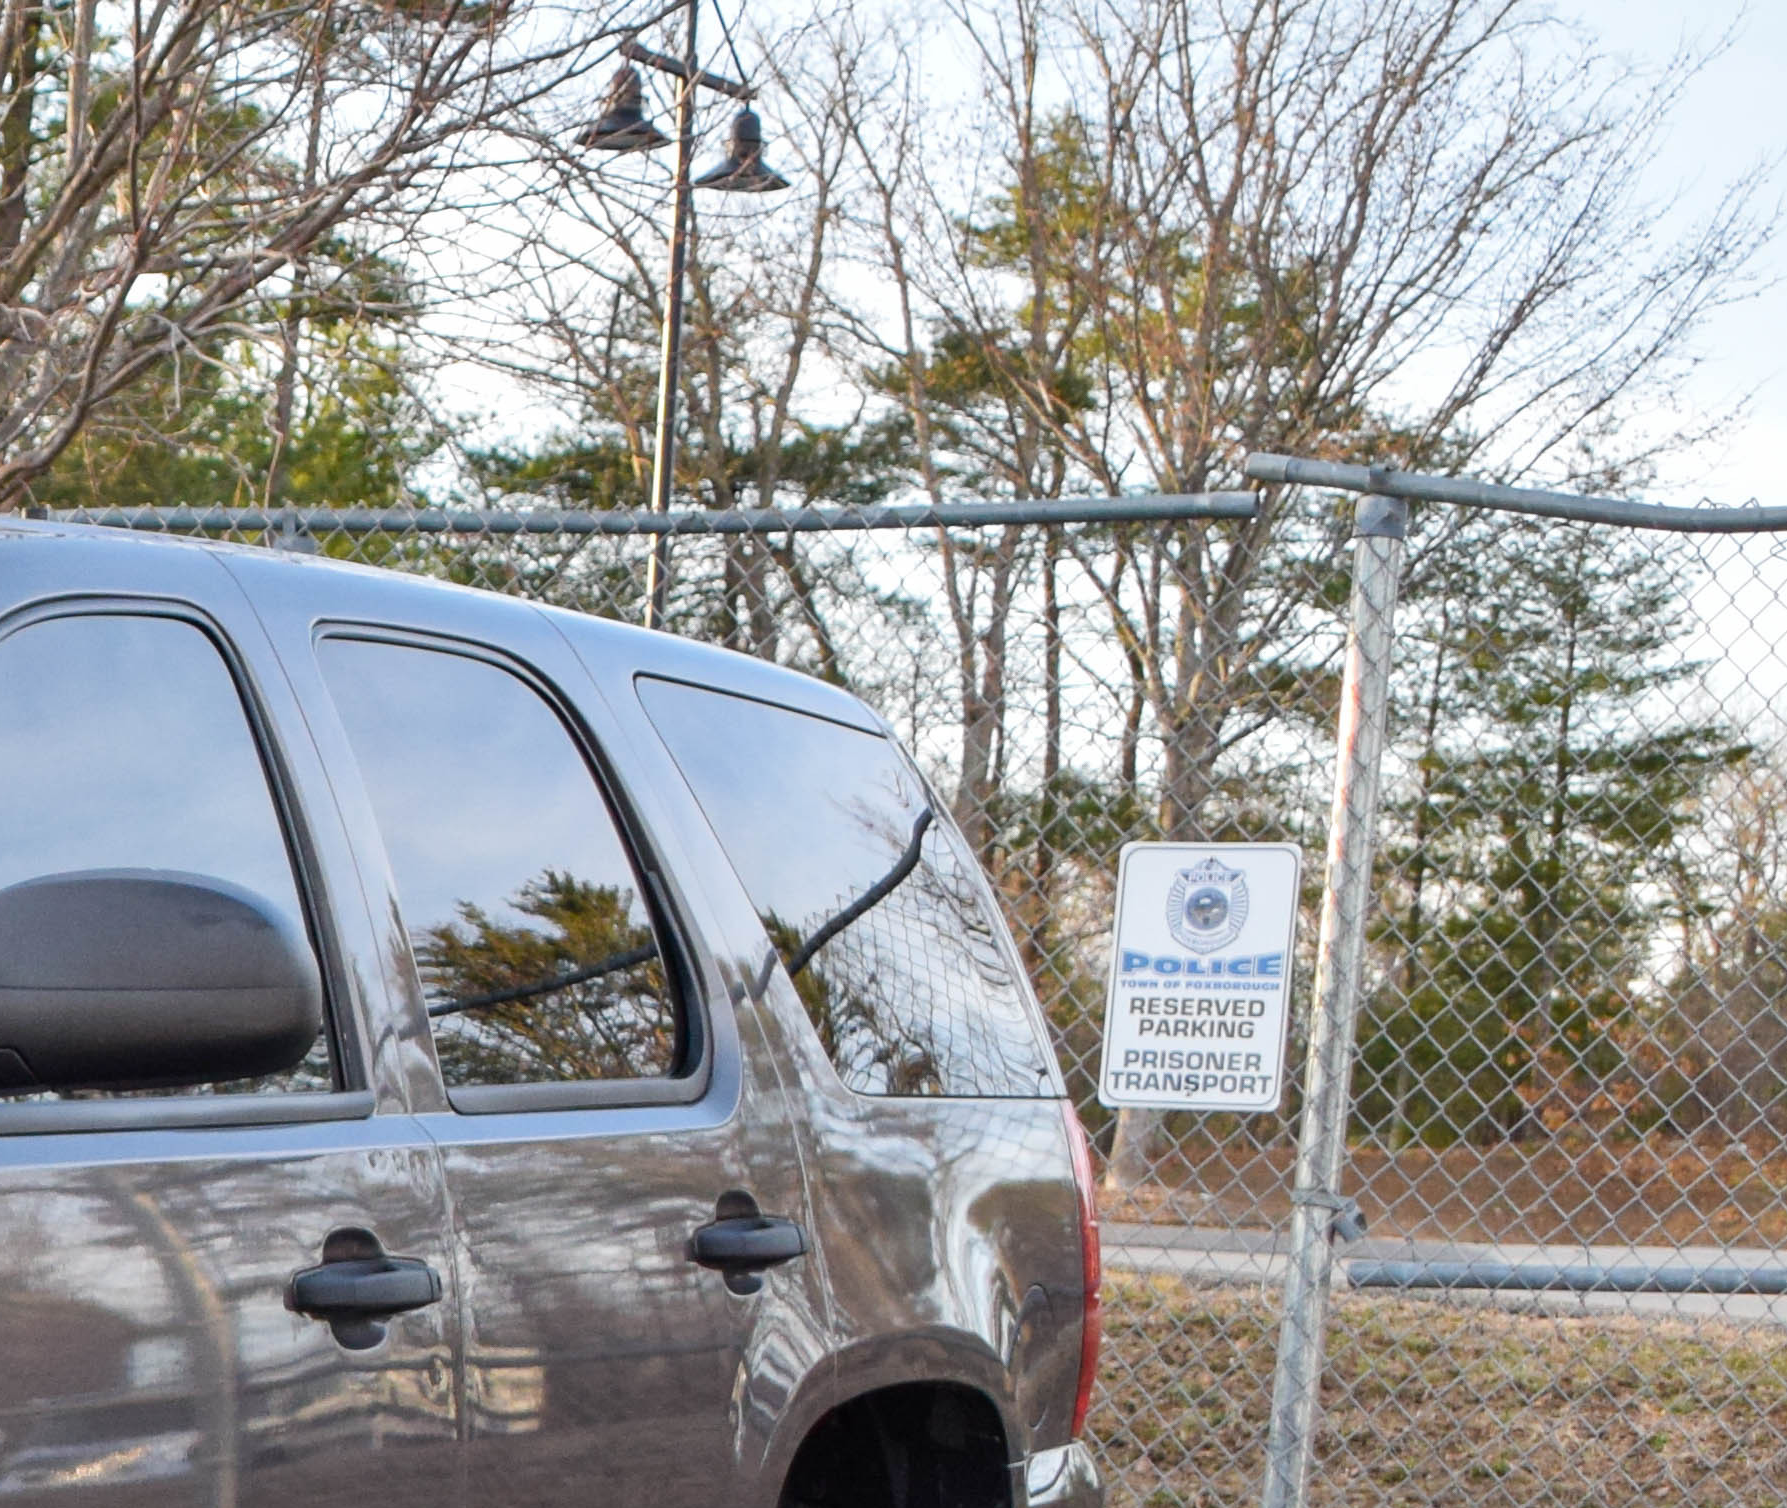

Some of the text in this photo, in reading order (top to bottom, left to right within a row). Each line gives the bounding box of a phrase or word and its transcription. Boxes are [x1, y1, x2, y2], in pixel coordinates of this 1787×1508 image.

[1120, 950, 1284, 977] POLICE
[1120, 979, 1280, 991] TOWN OF FOXBOROUGH
[1129, 996, 1266, 1017] RESERVED
[1138, 1018, 1256, 1039] PARKING
[1123, 1049, 1262, 1072] PRISONER
[1110, 1071, 1273, 1095] TRANSPORT
